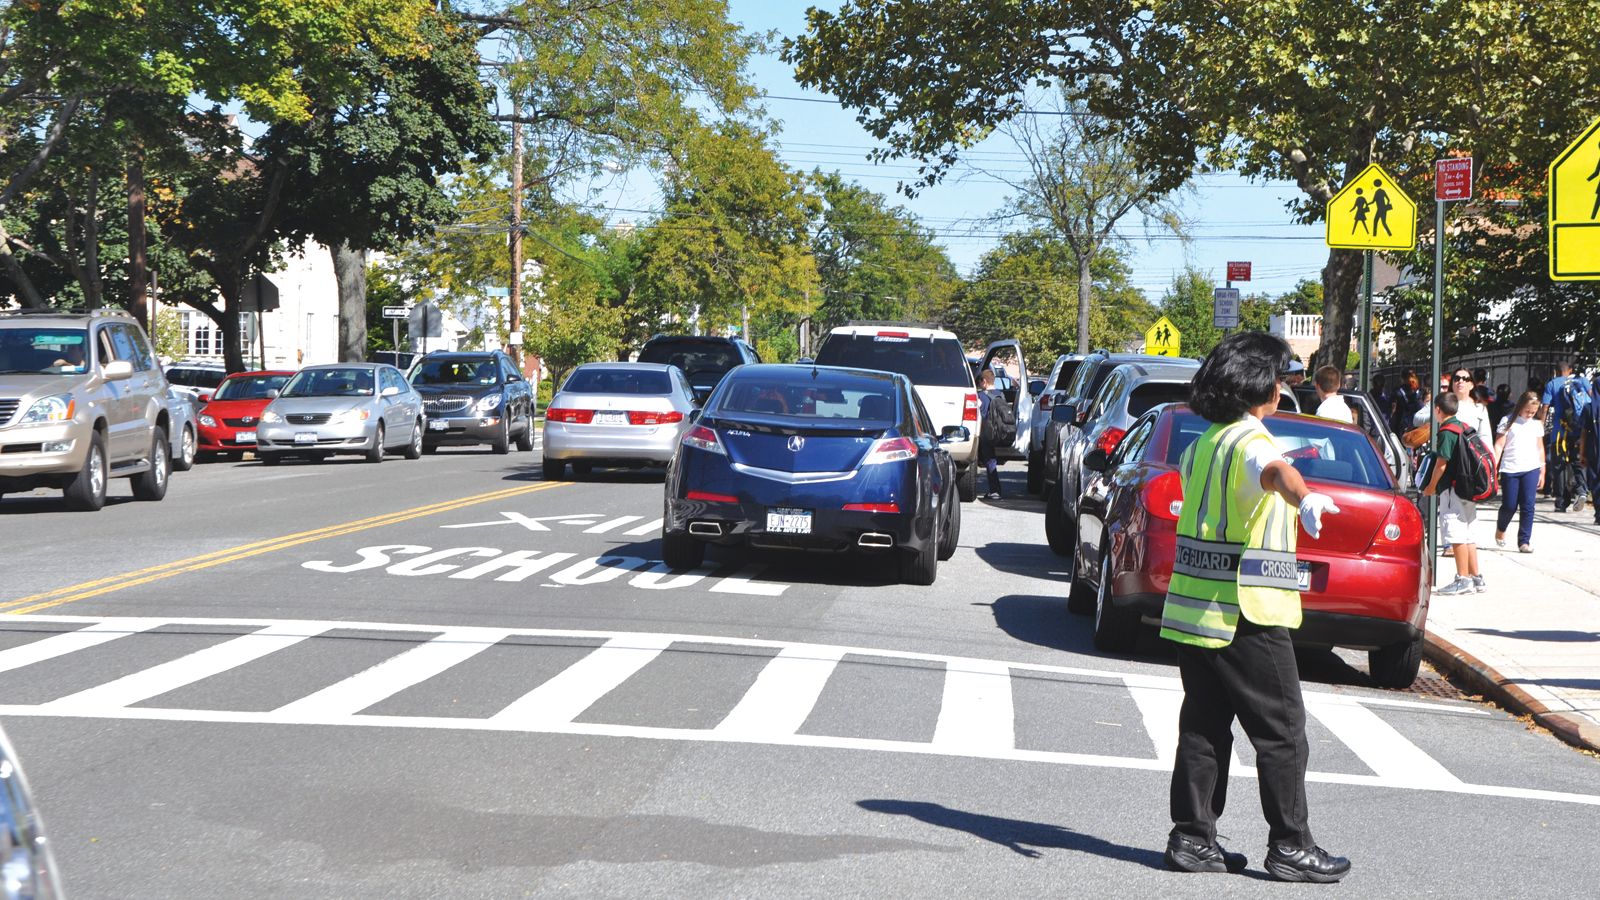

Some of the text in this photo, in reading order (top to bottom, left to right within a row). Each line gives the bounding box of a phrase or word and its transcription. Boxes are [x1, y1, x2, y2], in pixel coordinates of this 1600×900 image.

[1439, 162, 1469, 172] NO STANDING
[727, 429, 751, 437] ACURA
[1190, 550, 1231, 570] GUARD
